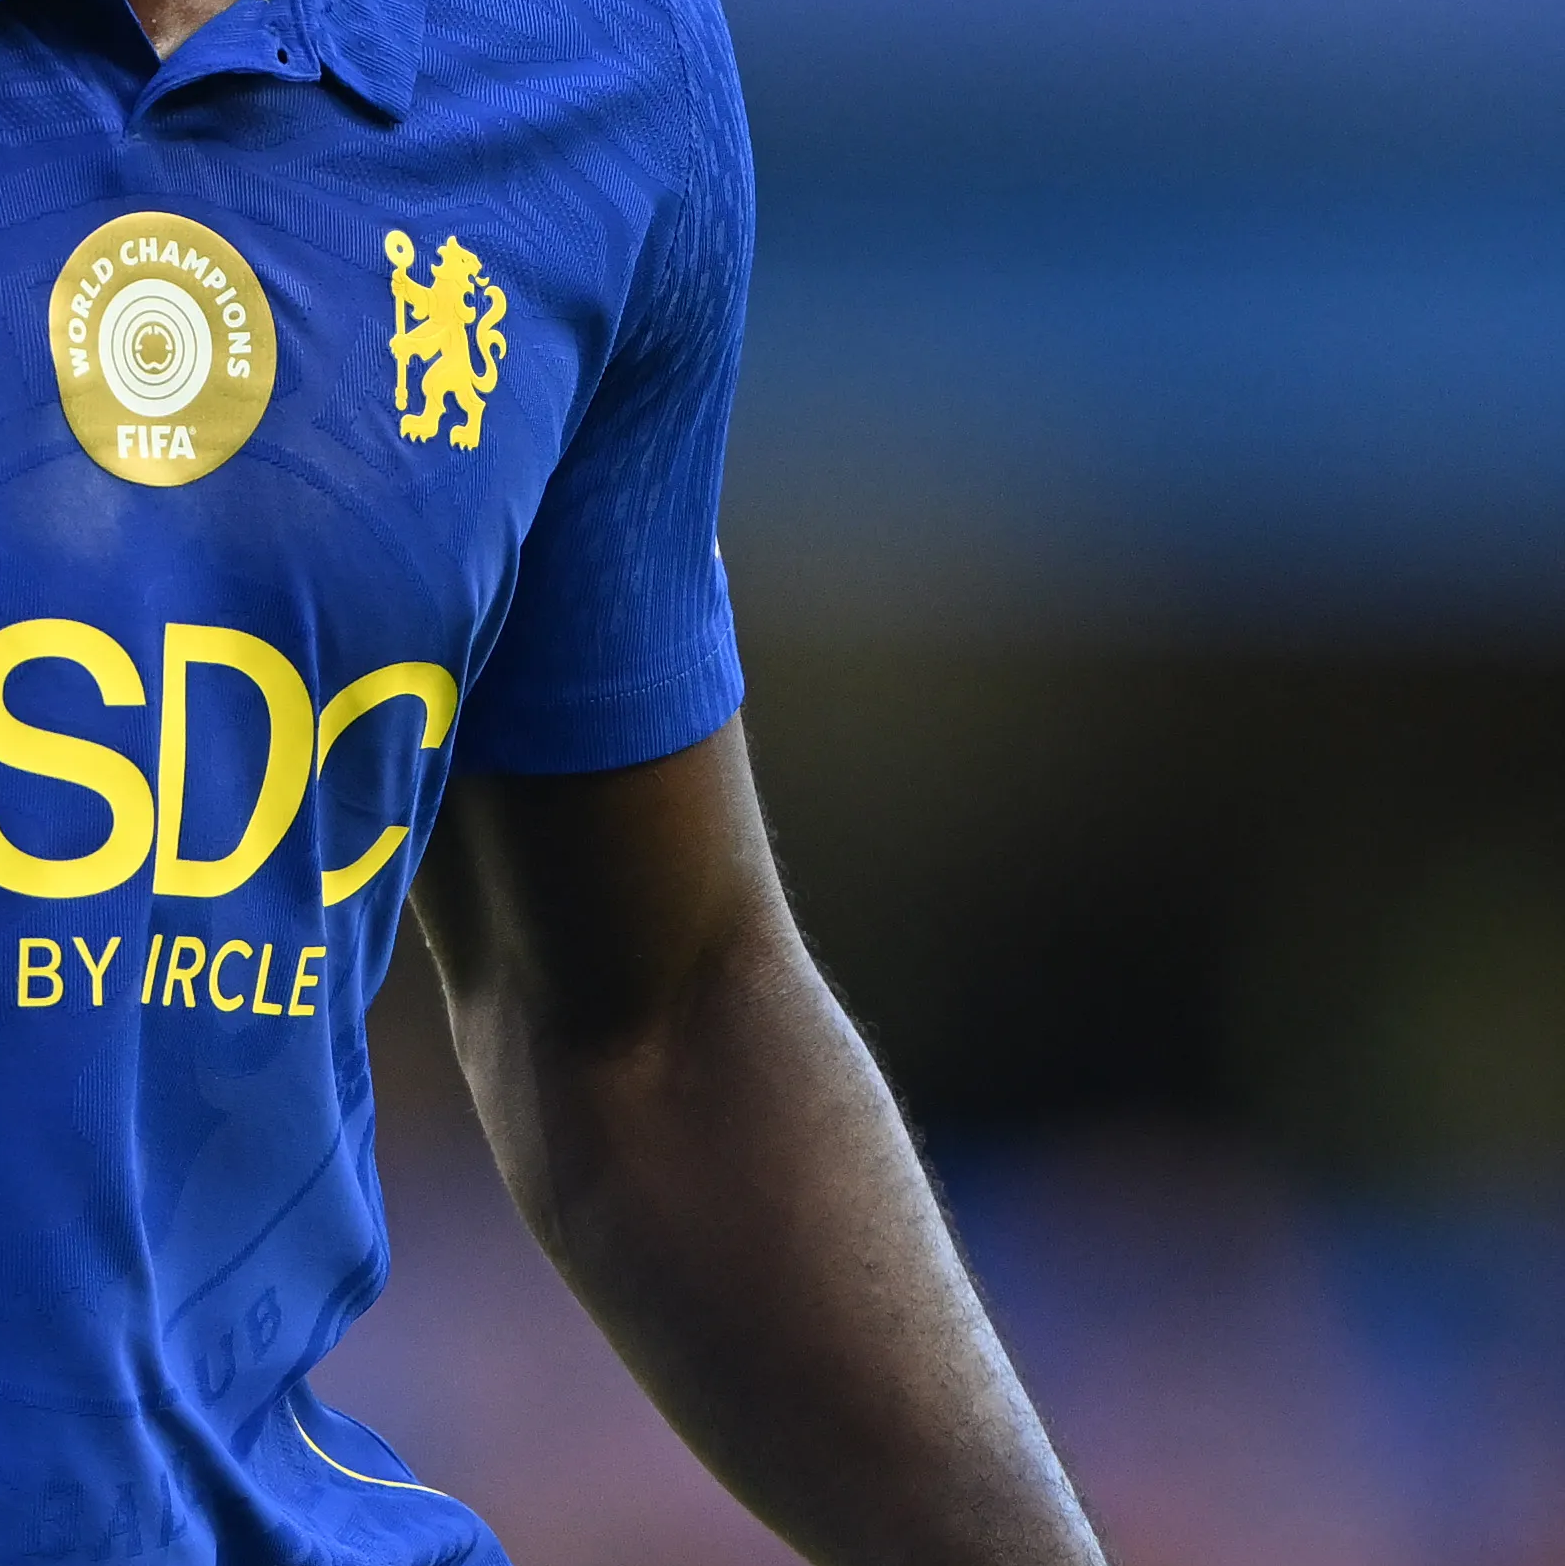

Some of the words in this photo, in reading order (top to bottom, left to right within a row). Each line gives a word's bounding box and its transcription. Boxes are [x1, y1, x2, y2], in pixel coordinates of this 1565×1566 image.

[65, 257, 114, 378] WORLD
[120, 237, 252, 378] CHAMPIONS
[116, 425, 196, 460] FIFA
[17, 935, 121, 1008] BY
[139, 933, 328, 1018] IRCLE
